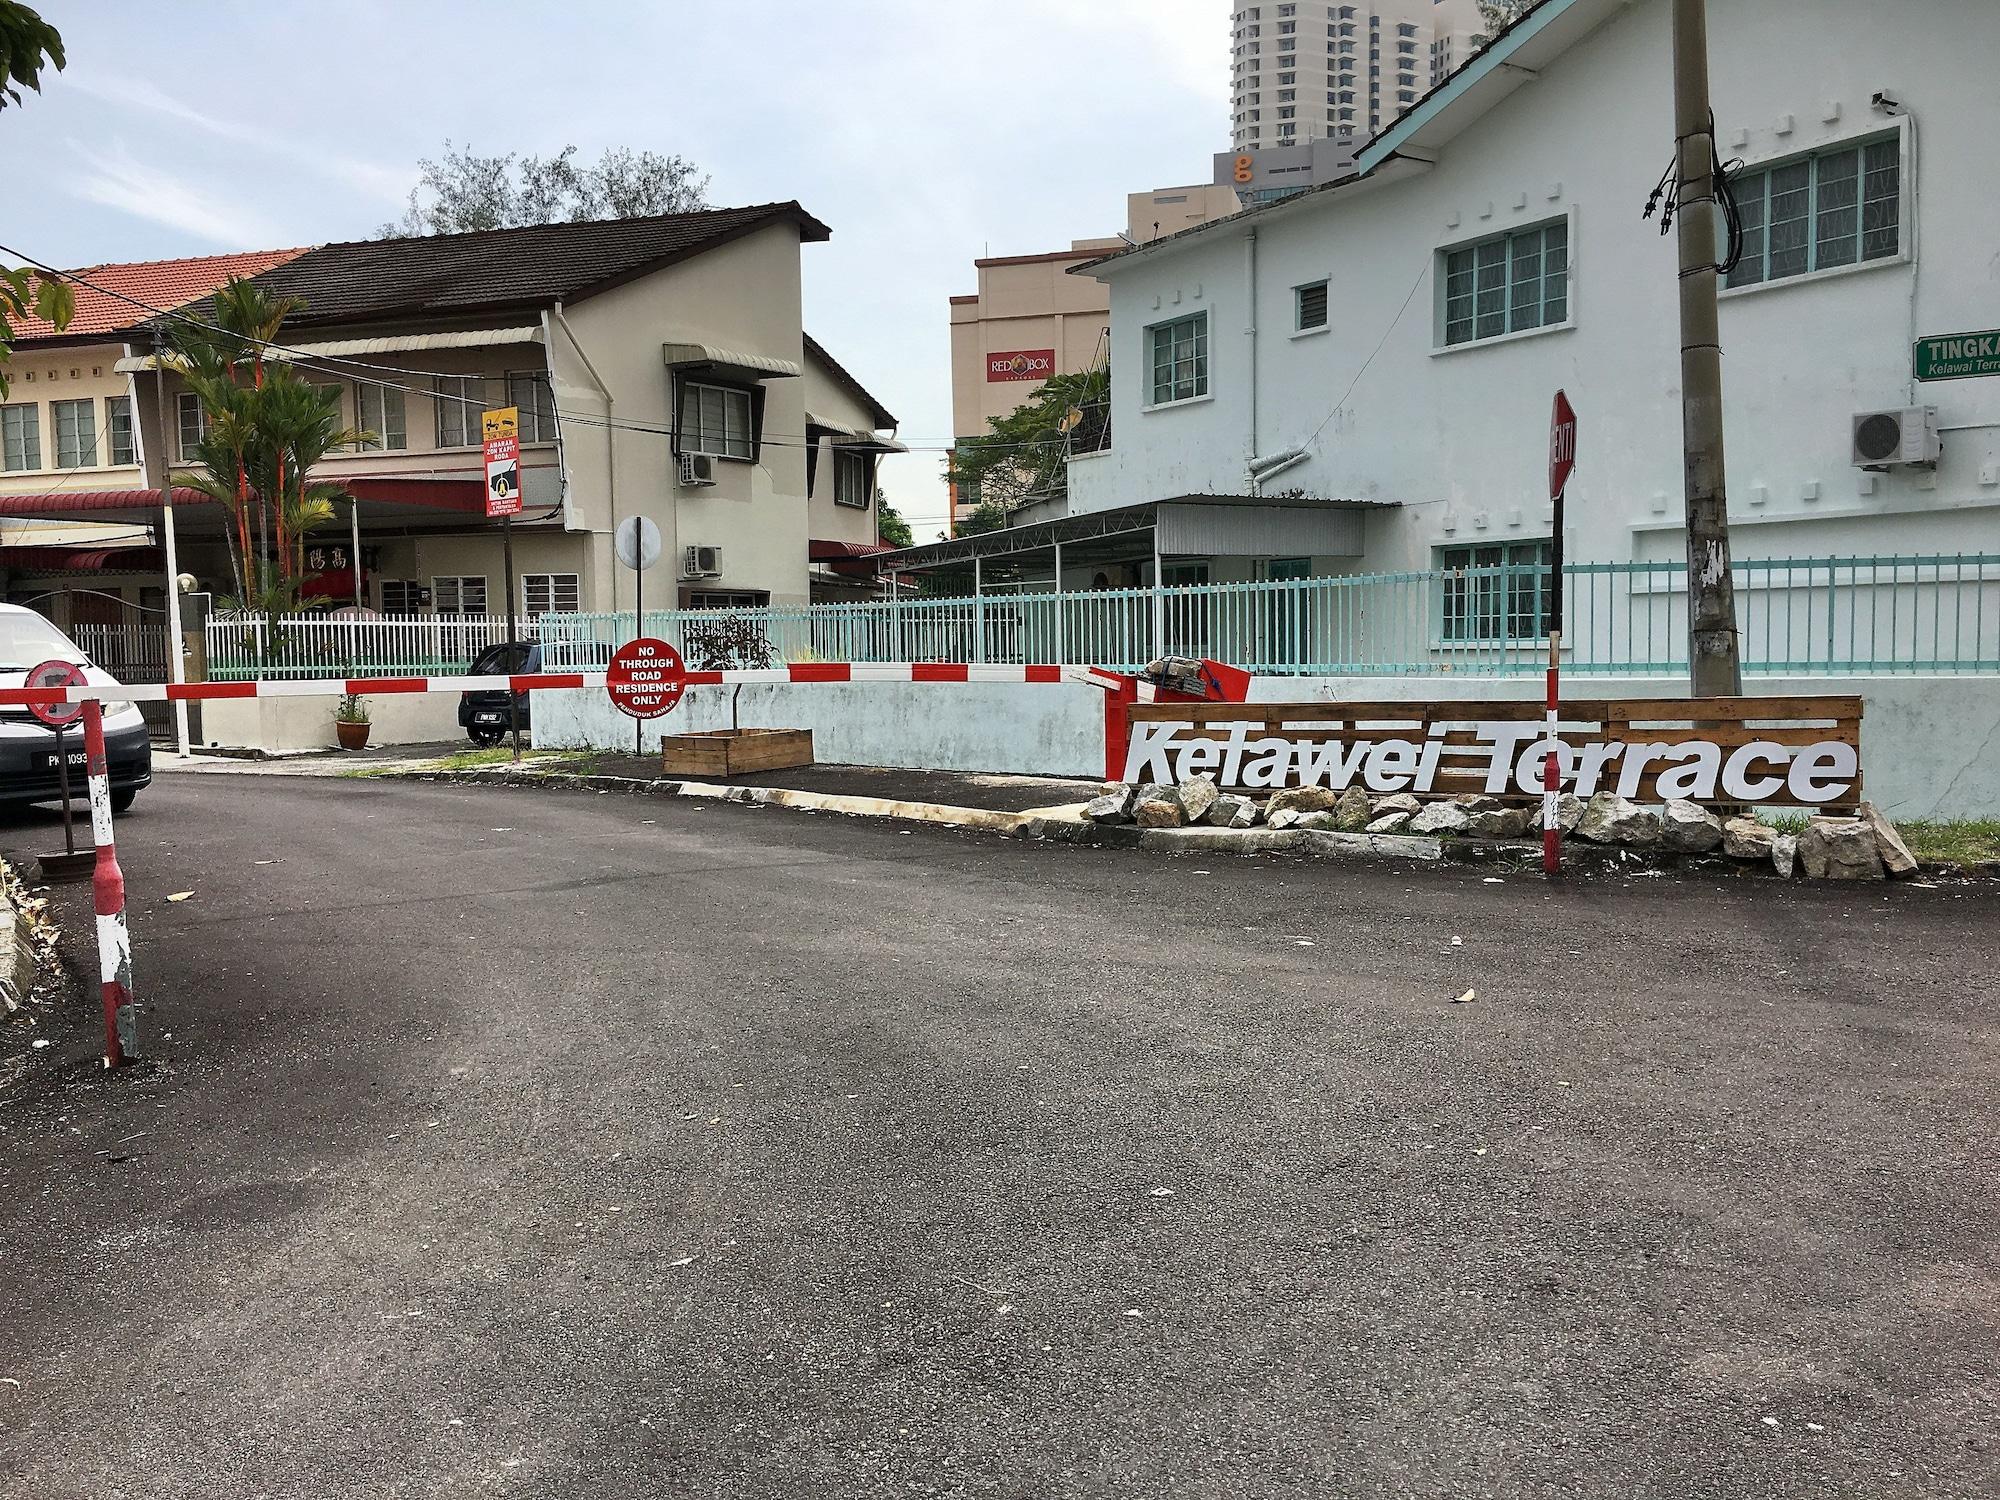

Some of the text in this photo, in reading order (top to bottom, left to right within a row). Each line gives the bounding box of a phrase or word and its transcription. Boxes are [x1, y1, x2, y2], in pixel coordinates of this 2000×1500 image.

[992, 358, 1049, 373] RED BOX
[1929, 360, 1973, 375] Kelawai
[490, 439, 513, 449] AMARAN
[487, 445, 516, 456] ZON KAPIT
[494, 452, 509, 461] RODA
[638, 647, 655, 656] NO
[619, 658, 674, 669] THROUGH
[631, 671, 662, 681] ROAD
[615, 682, 678, 694] RESIDENCE
[632, 695, 662, 705] ONLY
[617, 700, 676, 717] PENDUDUK SAHAJA
[67, 753, 88, 764] 1093
[1121, 720, 1858, 803] Kelawei Terrace
